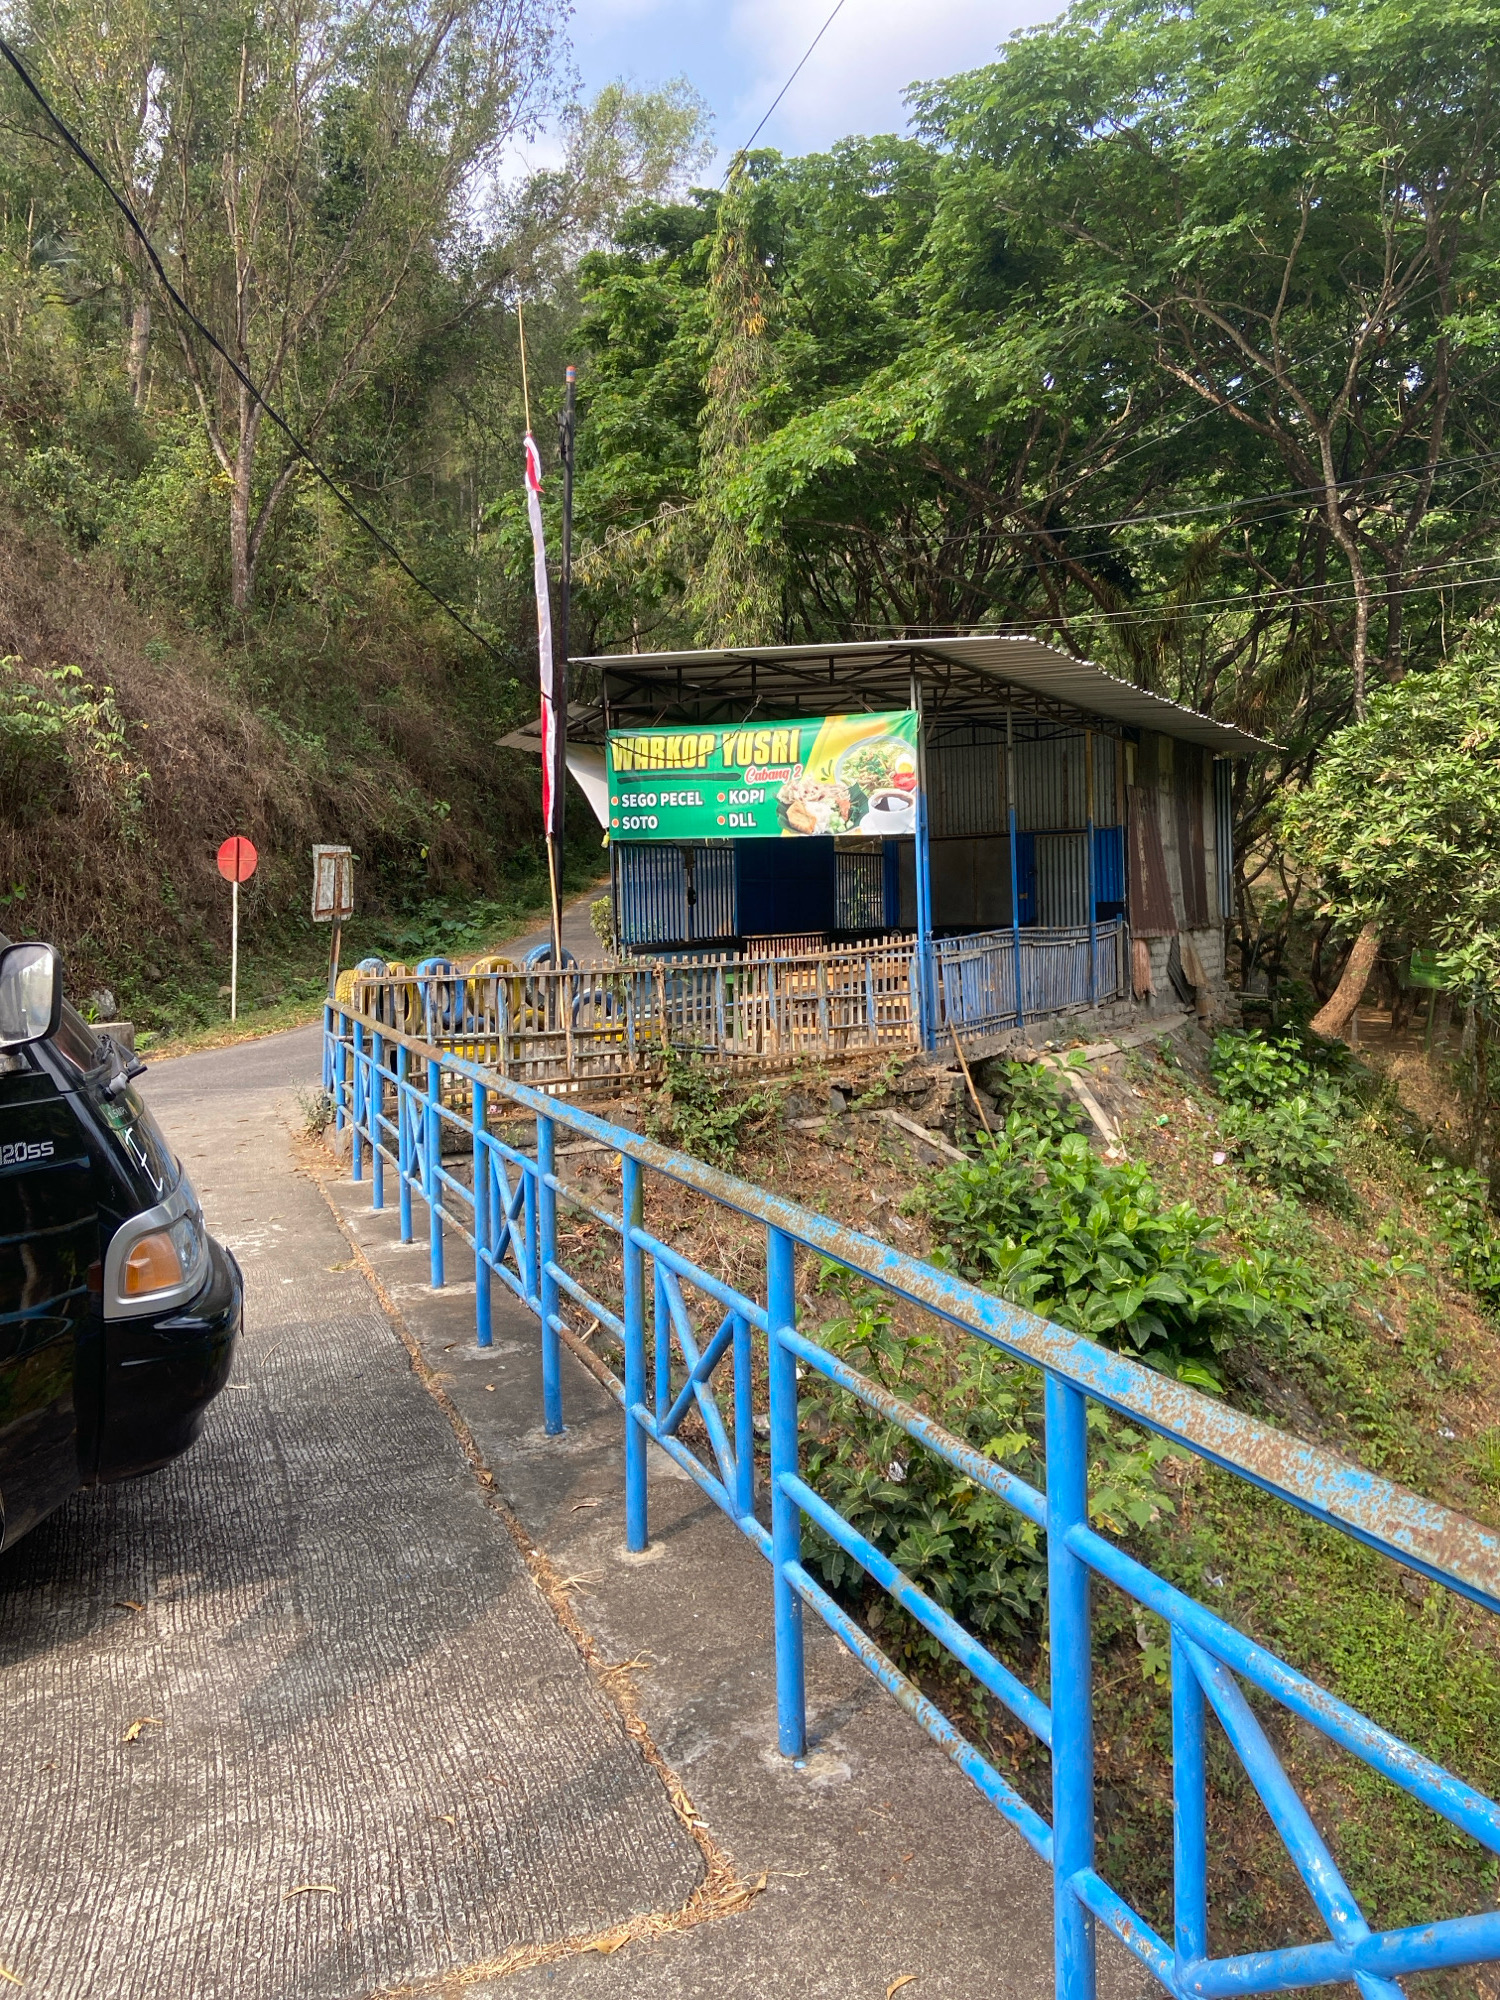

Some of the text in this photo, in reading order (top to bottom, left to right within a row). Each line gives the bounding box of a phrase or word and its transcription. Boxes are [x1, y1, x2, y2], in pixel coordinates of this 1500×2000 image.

[612, 728, 801, 772] WARKOP YUSRI
[745, 765, 803, 785] Cabang 2
[621, 791, 704, 808] SEGO PECEL
[728, 789, 765, 804] KOPI
[622, 816, 658, 830] SOTO
[728, 813, 757, 828] DLL
